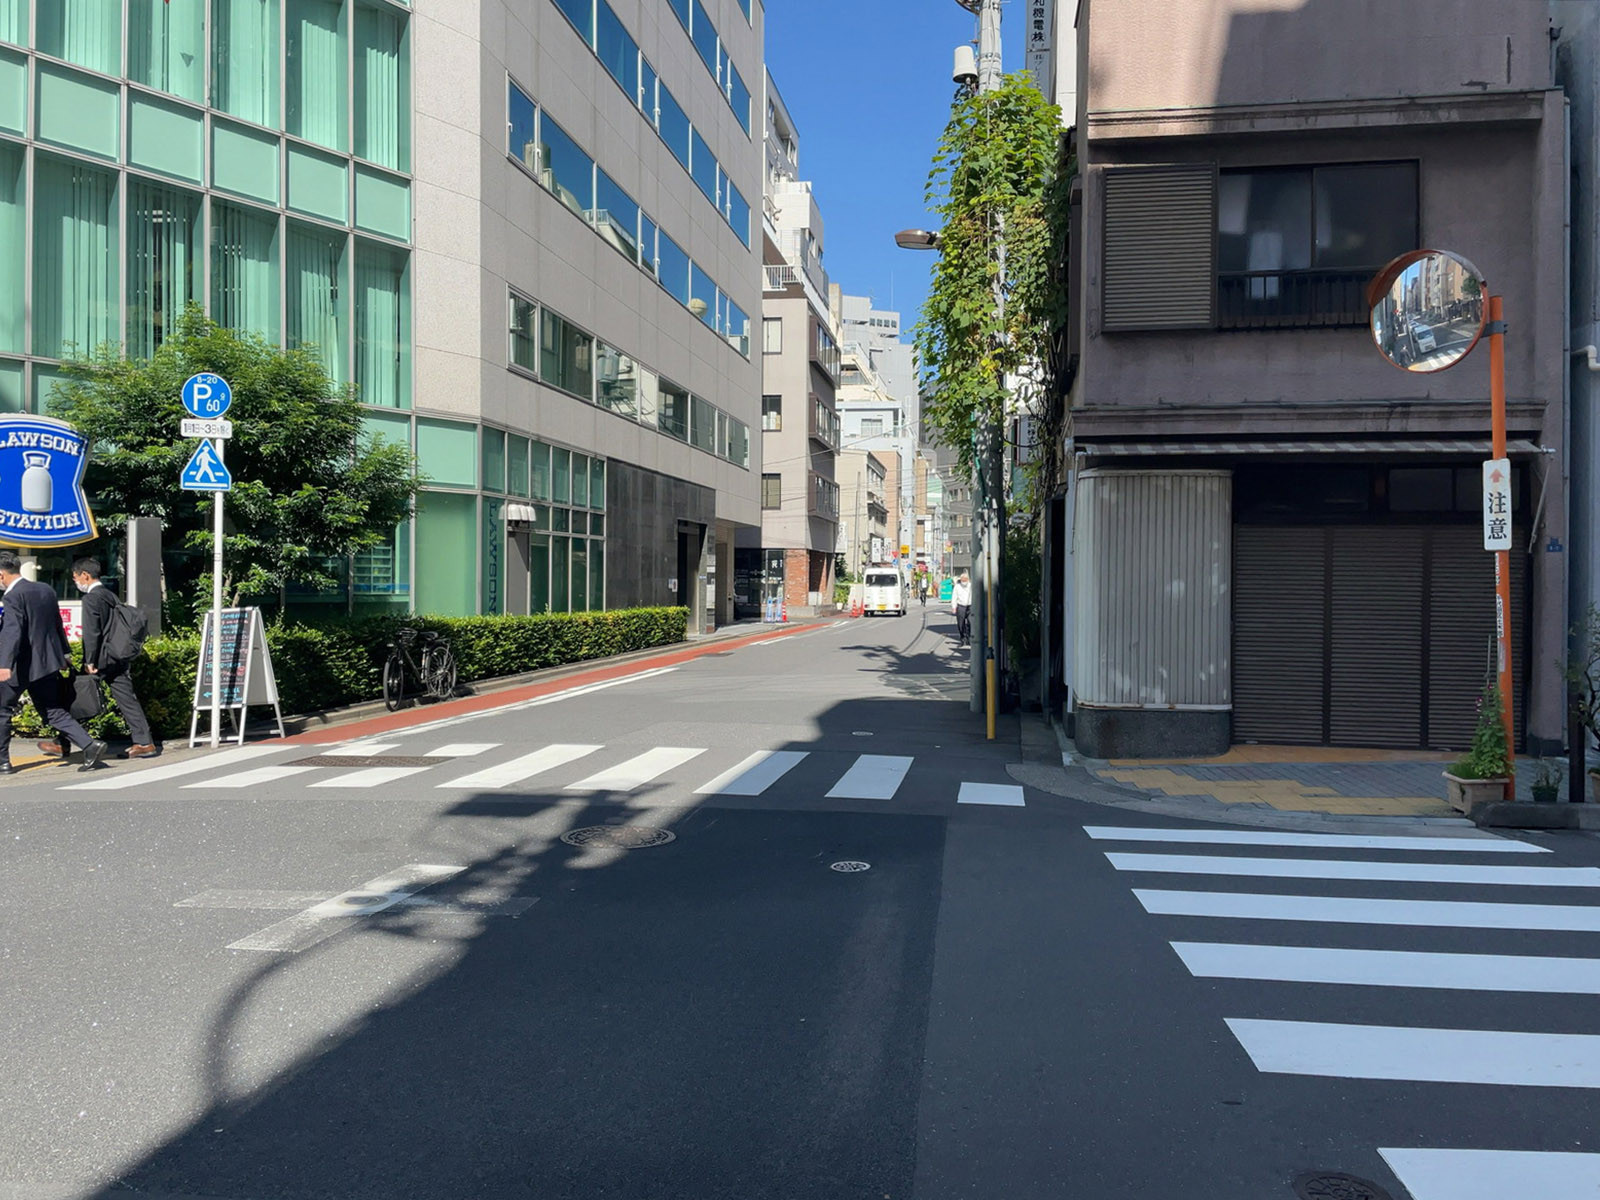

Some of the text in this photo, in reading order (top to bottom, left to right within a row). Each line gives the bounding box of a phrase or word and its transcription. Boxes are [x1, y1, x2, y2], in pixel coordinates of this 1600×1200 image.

[193, 384, 212, 411] P
[206, 400, 220, 412] 60
[1488, 491, 1507, 540] 注意
[489, 503, 497, 614] LAWSON
